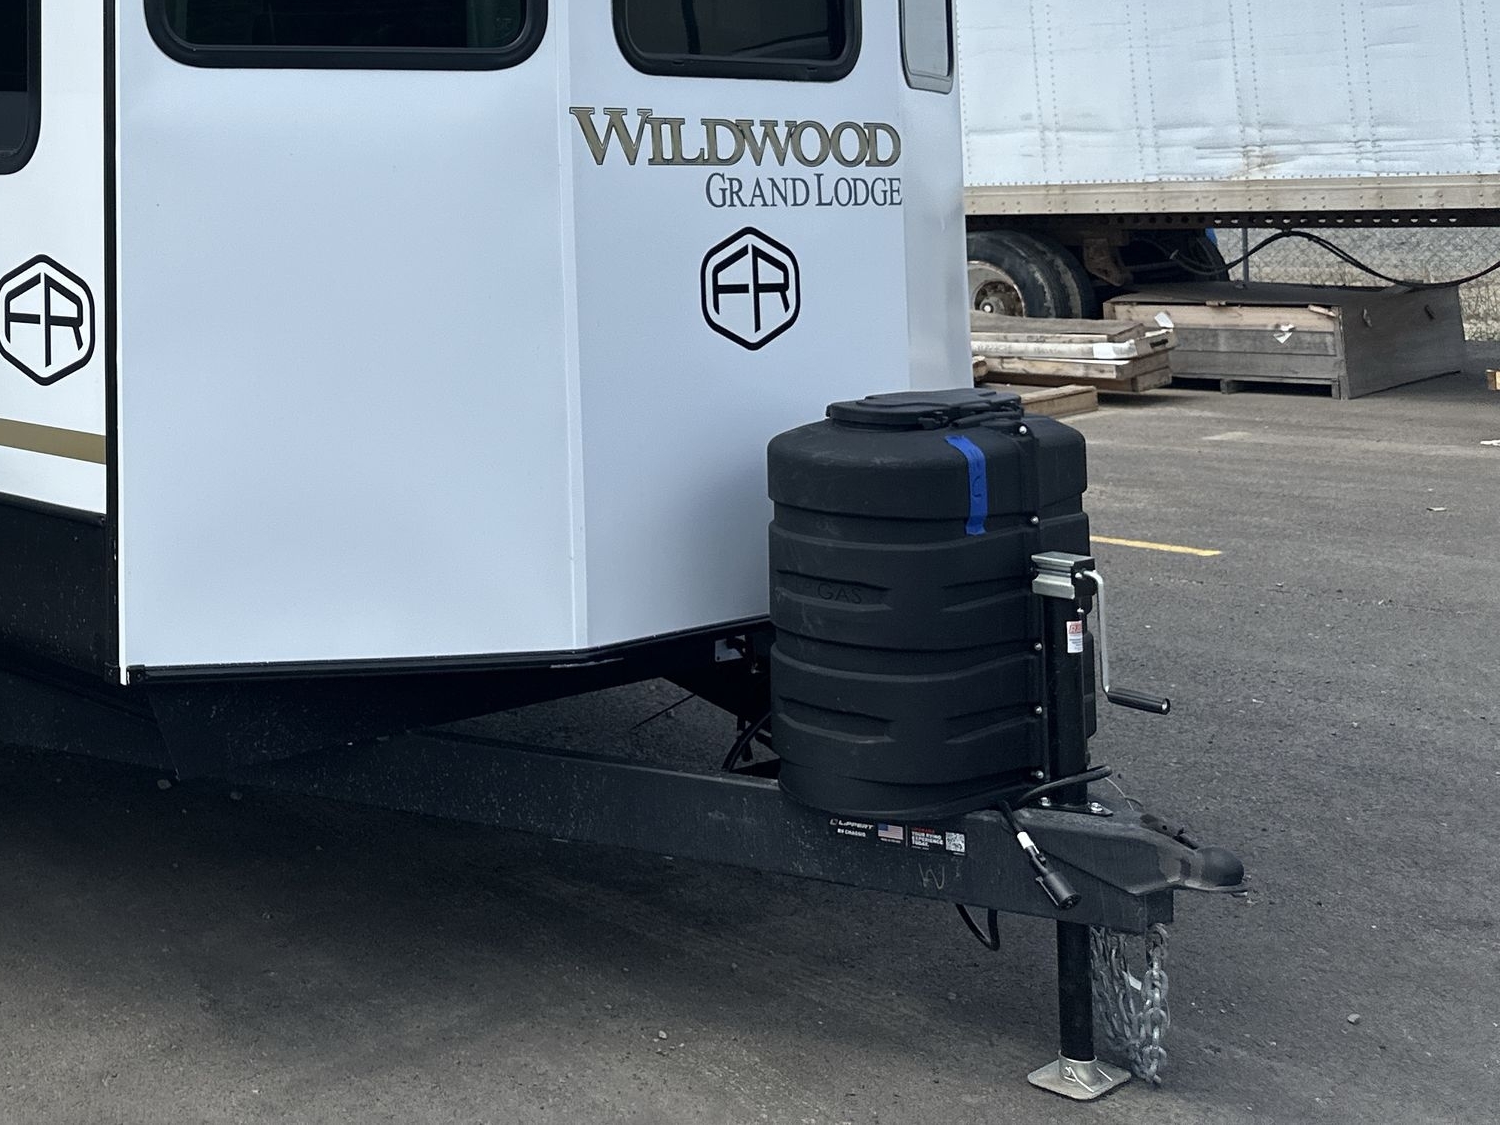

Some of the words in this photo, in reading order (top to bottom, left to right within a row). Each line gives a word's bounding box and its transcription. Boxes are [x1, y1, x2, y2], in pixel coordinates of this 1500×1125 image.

[568, 106, 902, 168] WILDWOOD
[704, 171, 811, 208] GRAND
[814, 173, 903, 208] LODGE
[817, 581, 863, 605] GAS
